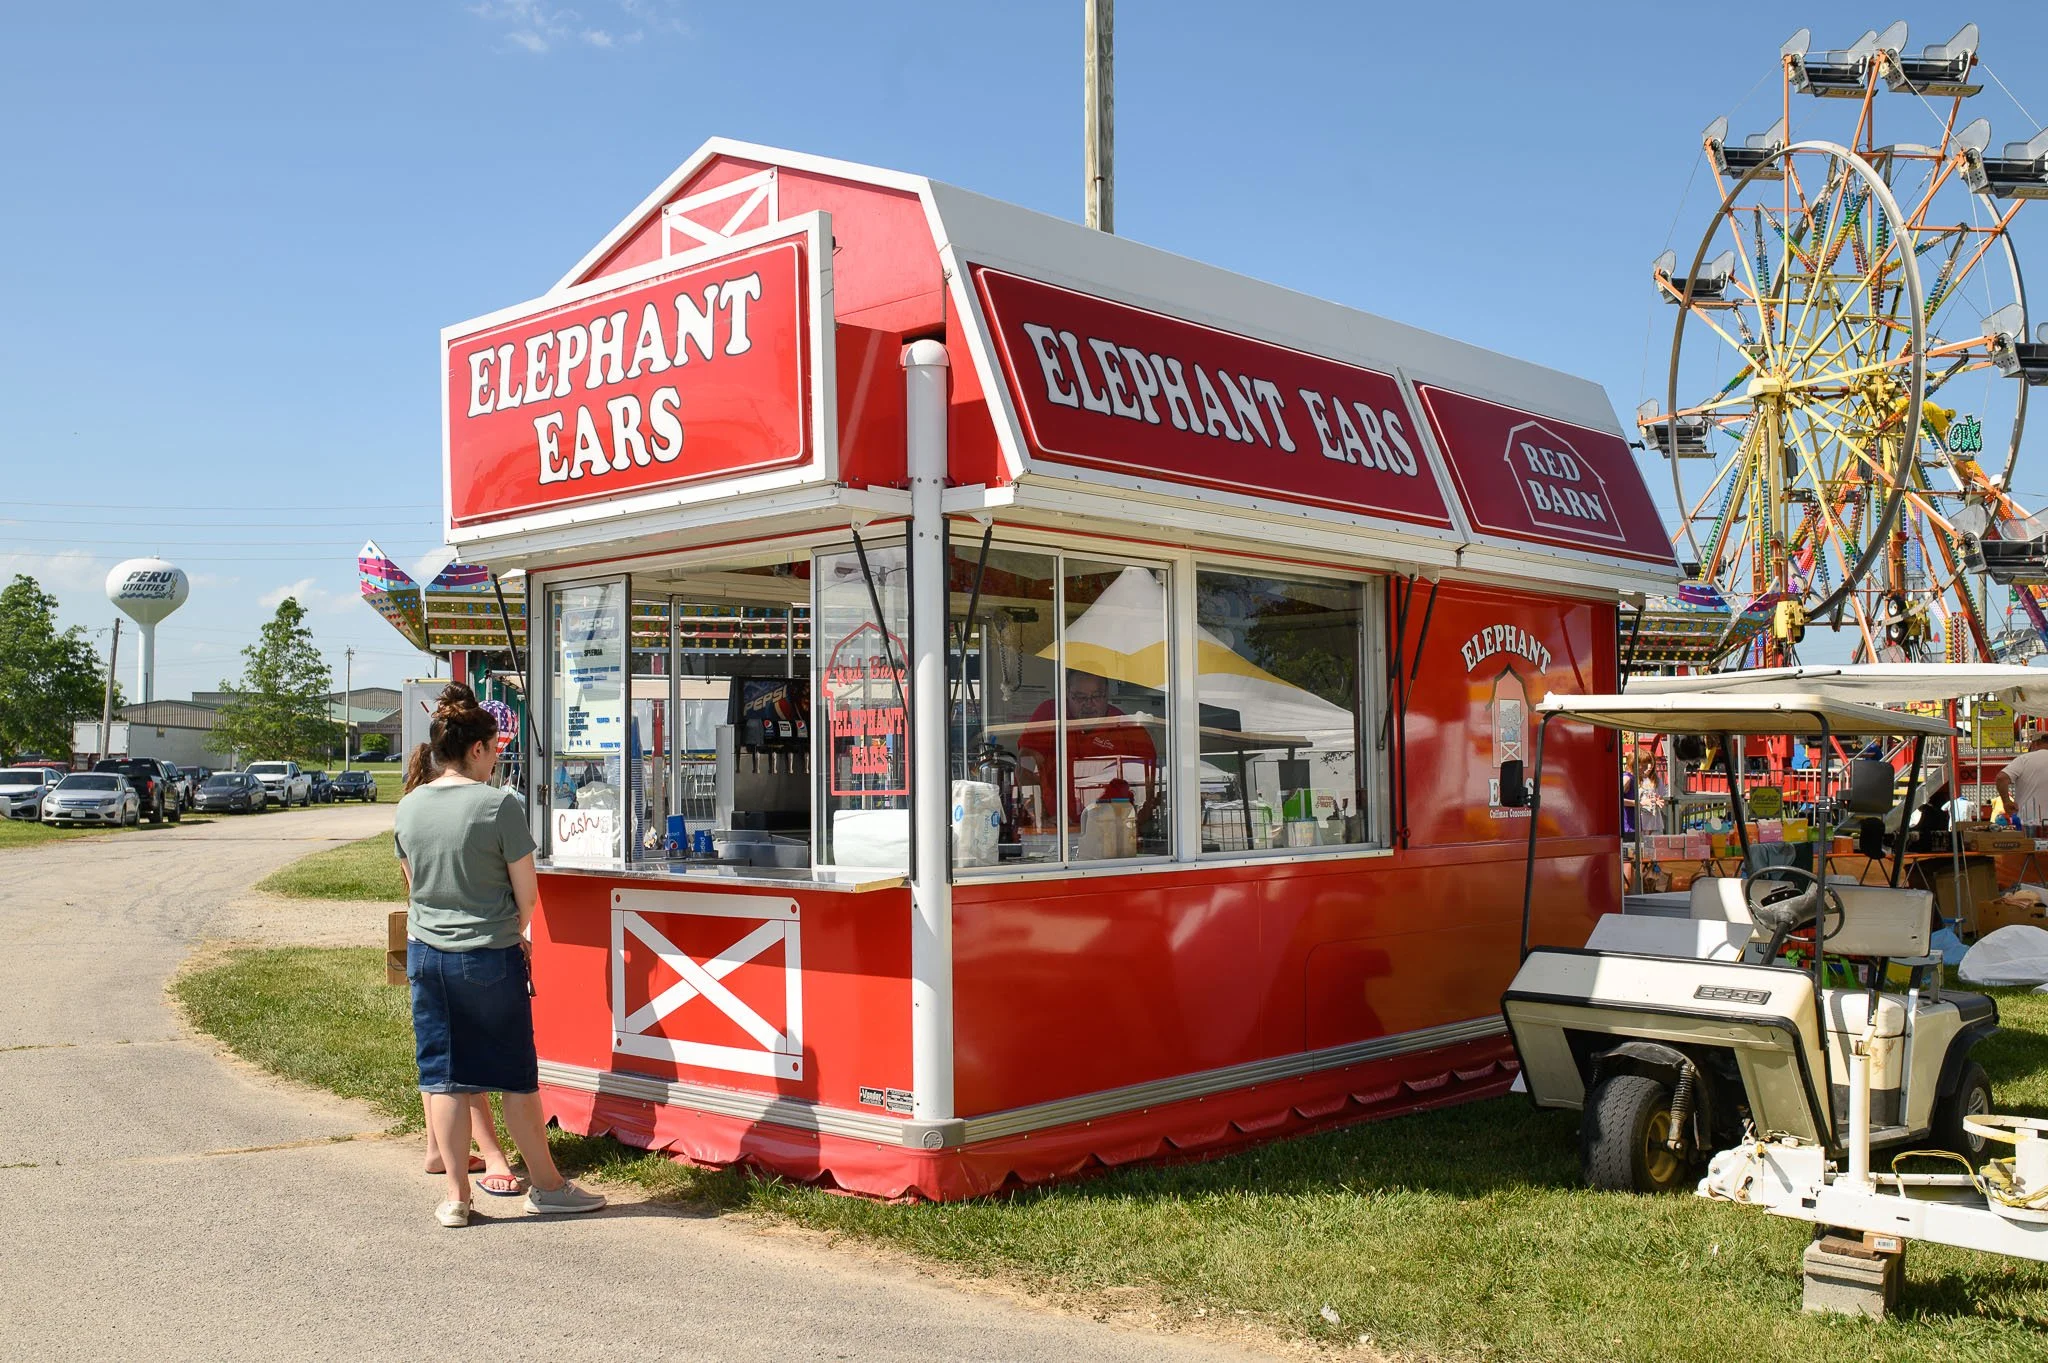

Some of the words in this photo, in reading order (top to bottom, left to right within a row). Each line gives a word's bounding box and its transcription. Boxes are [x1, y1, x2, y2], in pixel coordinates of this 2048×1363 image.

[467, 272, 761, 418] ELEPHANT
[1022, 321, 1297, 453] ELEPHANT
[1297, 387, 1420, 476] EARS
[532, 386, 684, 486] EARS
[1520, 442, 1581, 482] RED
[1526, 479, 1608, 523] BARN
[122, 583, 167, 592] UTILITIES
[126, 570, 172, 584] PERU
[579, 616, 615, 631] PEPSI
[1460, 624, 1552, 676] ELEPHANT
[833, 657, 864, 687] Red
[743, 684, 788, 716] PEPSI
[834, 707, 904, 737] ELEPHANT
[851, 745, 888, 775] EARS
[1488, 777, 1535, 808] ES
